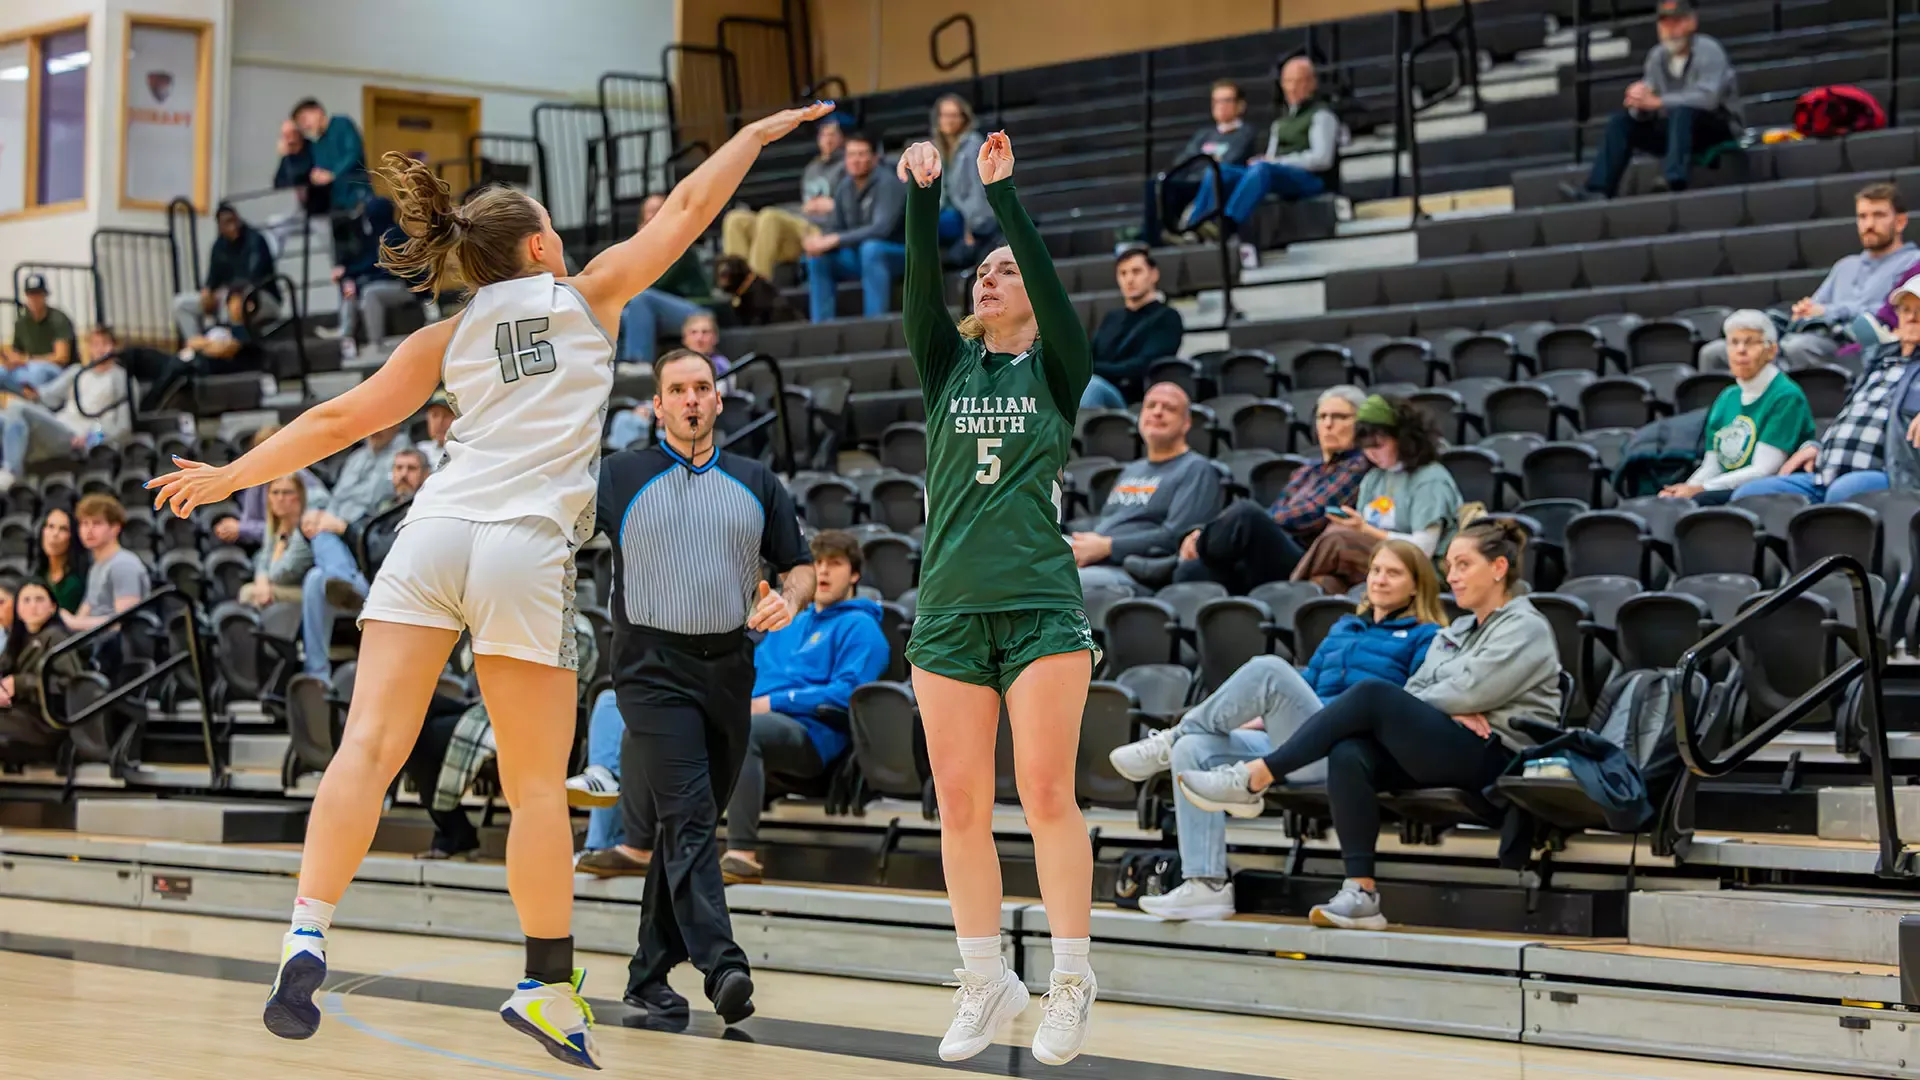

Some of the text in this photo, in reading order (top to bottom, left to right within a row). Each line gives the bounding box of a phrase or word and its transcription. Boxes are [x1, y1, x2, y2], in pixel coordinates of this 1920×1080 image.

[495, 316, 556, 383] 15
[955, 416, 1025, 433] SMITH
[975, 438, 1002, 484] 5
